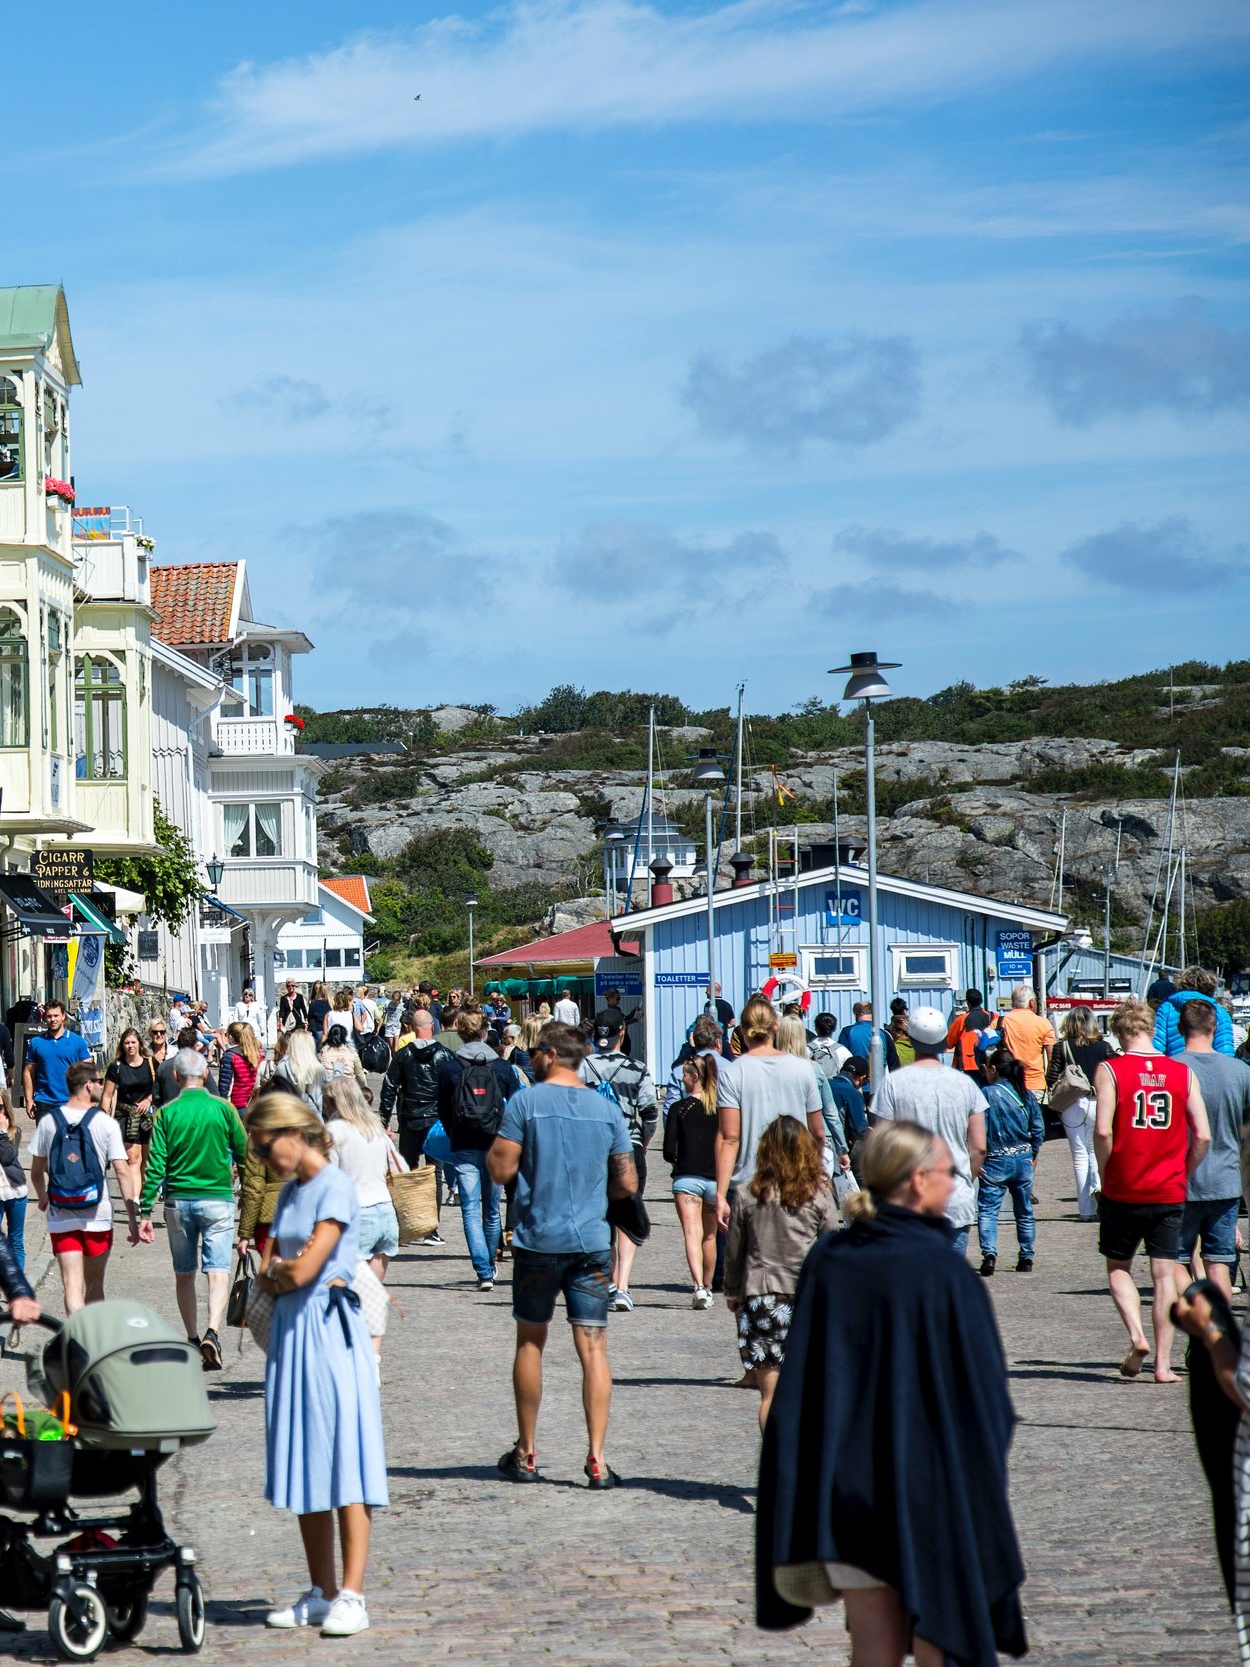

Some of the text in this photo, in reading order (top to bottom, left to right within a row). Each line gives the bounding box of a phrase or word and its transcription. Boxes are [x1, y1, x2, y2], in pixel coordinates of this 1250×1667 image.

[39, 851, 85, 864] CIGARR
[35, 864, 78, 878] PAPPER
[828, 898, 859, 916] WC
[1000, 932, 1030, 940] SOPOR
[1001, 941, 1030, 949] WASTE
[1003, 949, 1027, 959] MÜLL
[656, 975, 697, 983] TOALETTER
[1132, 1089, 1173, 1130] 13
